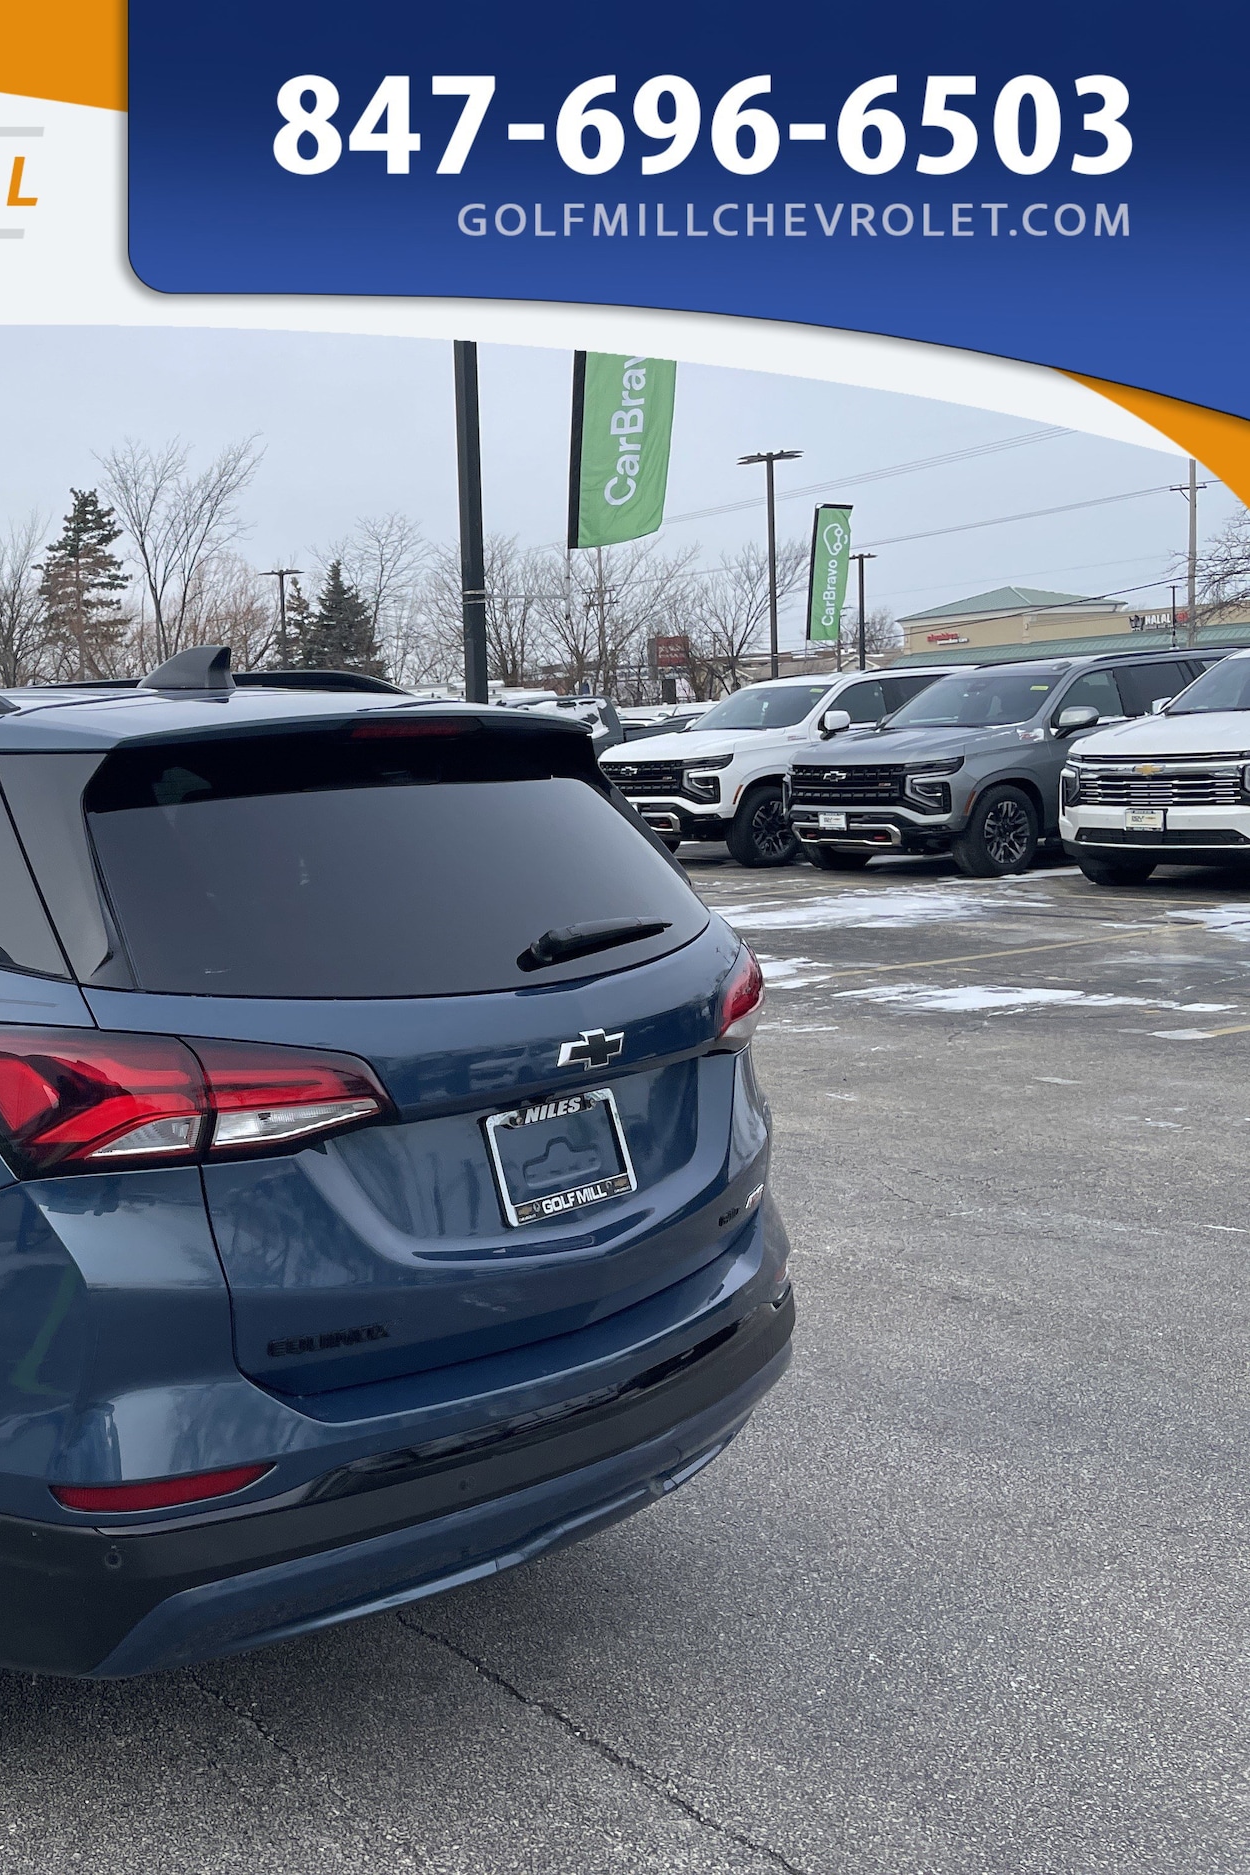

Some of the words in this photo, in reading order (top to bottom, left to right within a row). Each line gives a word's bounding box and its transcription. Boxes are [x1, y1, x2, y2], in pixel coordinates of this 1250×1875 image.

[821, 559, 838, 626] CarBravo
[1145, 613, 1171, 625] HALAL
[524, 1096, 582, 1124] NILES
[542, 1193, 575, 1214] GOLF
[575, 1185, 607, 1204] MILL
